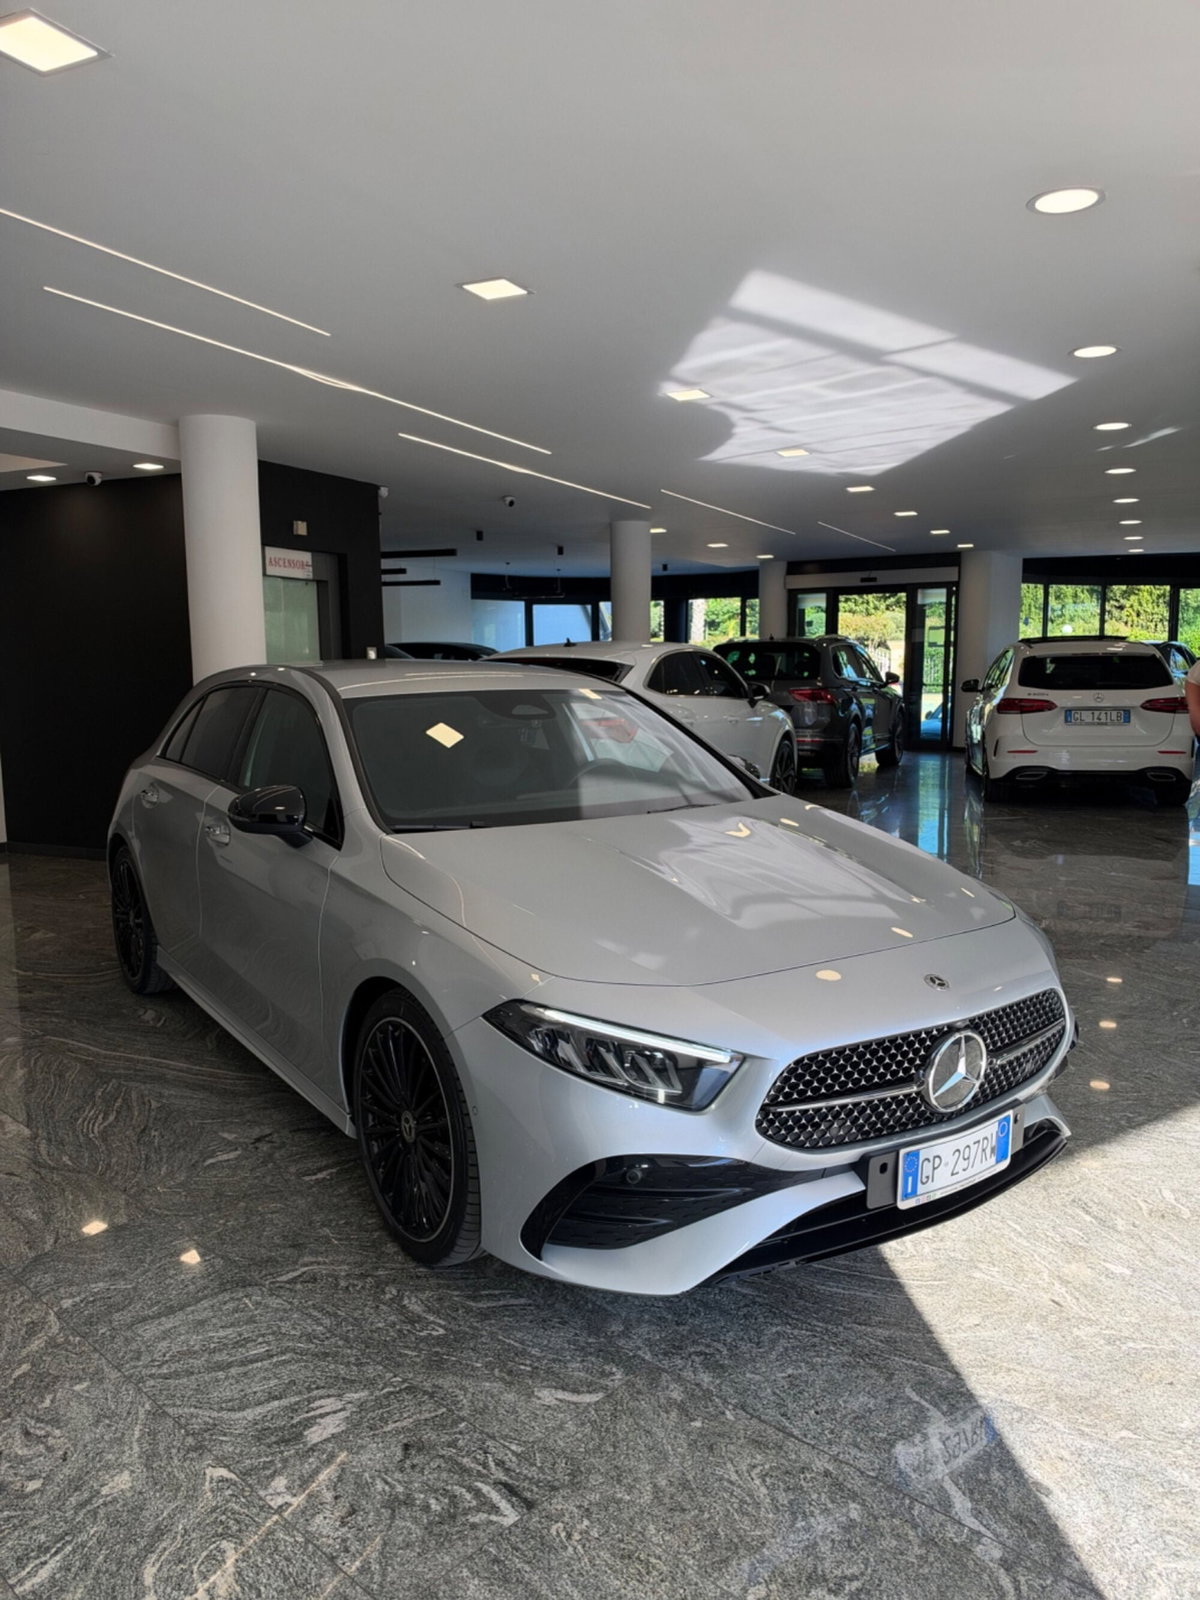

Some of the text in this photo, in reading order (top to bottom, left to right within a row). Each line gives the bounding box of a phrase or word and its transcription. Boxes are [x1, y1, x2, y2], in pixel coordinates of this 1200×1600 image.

[1073, 711, 1085, 722] GL
[1090, 711, 1123, 722] 141LB
[919, 1154, 943, 1186] GP
[950, 1131, 998, 1177] 297RW
